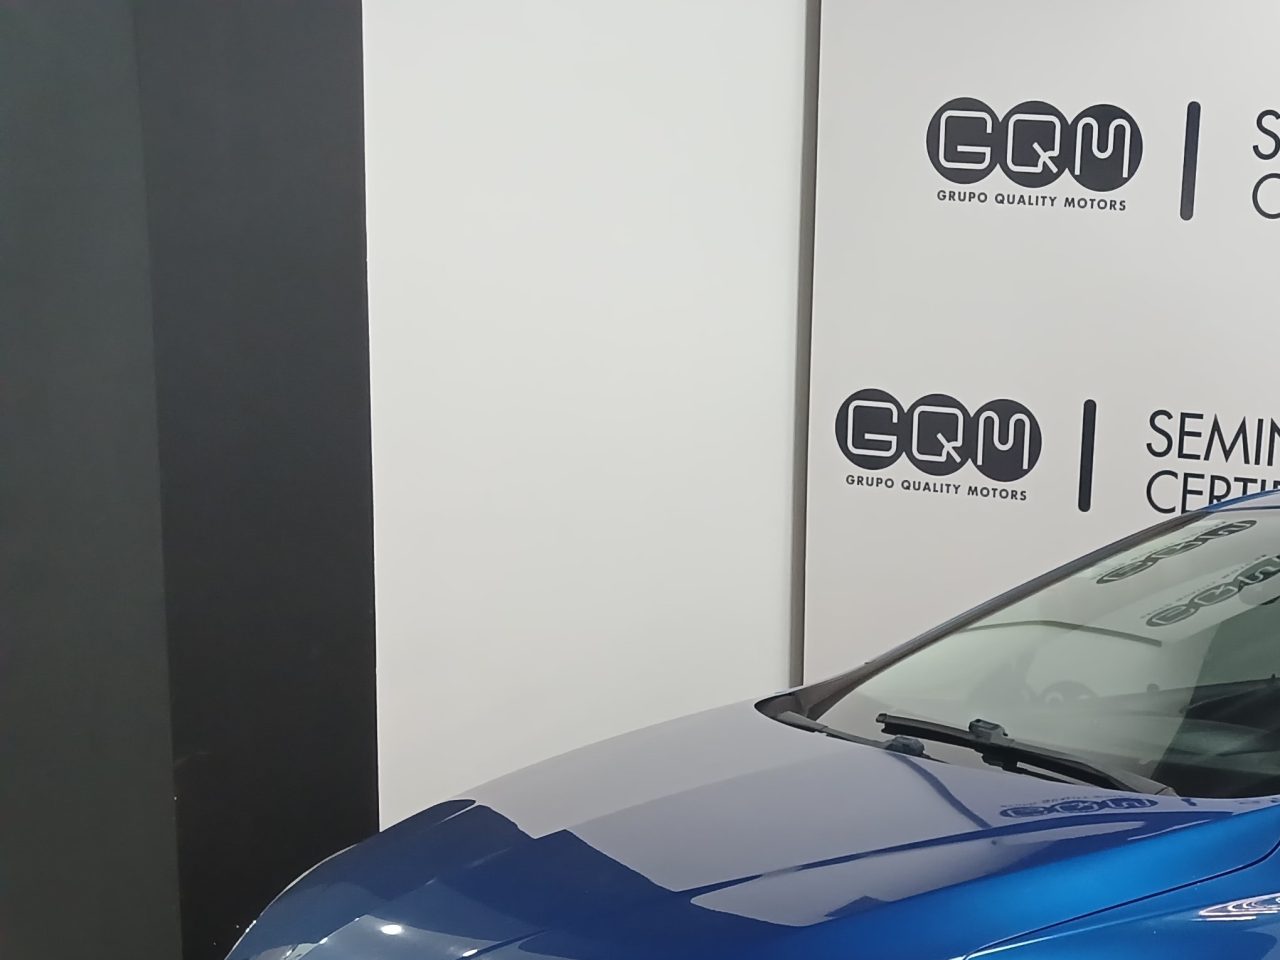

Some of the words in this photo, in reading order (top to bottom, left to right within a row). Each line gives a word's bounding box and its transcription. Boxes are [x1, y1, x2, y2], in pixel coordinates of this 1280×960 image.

[934, 107, 1134, 181] GQM
[936, 189, 988, 203] GRUPO
[994, 193, 1057, 207] QUALITY
[1063, 197, 1127, 212] MOTORS
[843, 398, 1034, 471] GQM
[845, 474, 895, 489] GRUPO
[900, 479, 961, 495] QUALITY
[967, 485, 1028, 502] MOTORS
